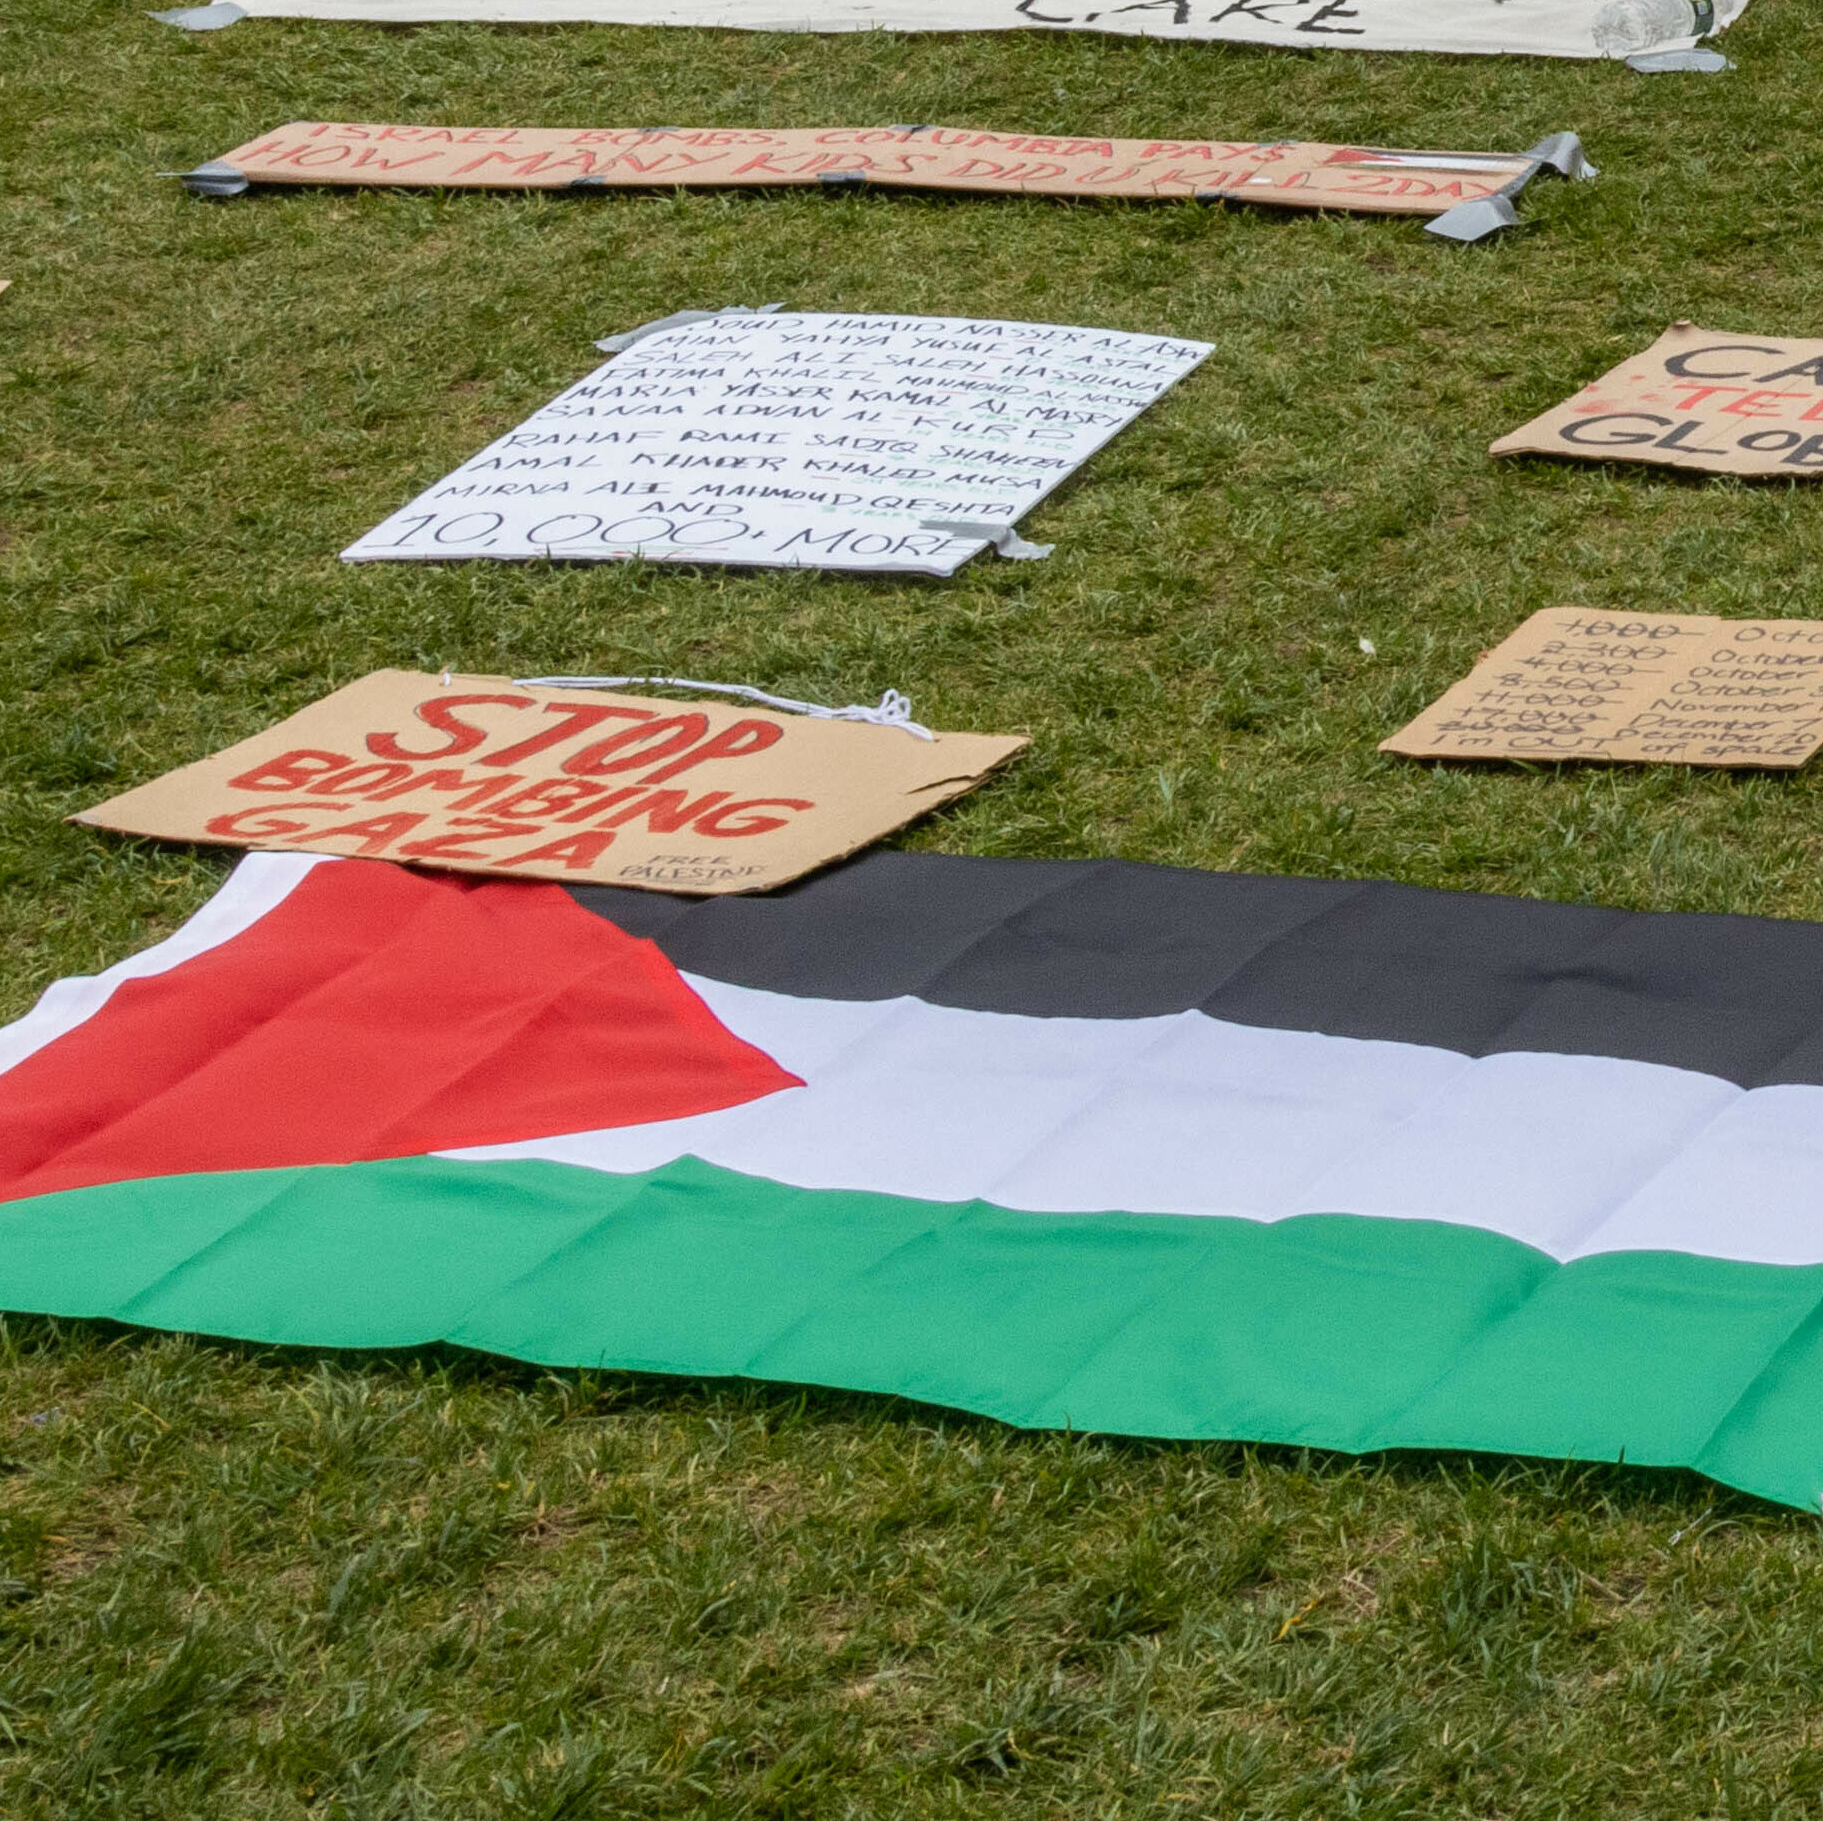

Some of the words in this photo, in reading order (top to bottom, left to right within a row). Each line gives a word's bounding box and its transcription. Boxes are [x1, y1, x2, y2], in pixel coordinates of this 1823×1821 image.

[310, 122, 524, 147] ISRAEL
[813, 125, 1115, 160] COLUMBIA
[1140, 139, 1304, 164] PAYS
[236, 140, 448, 172] HOW
[450, 149, 733, 176] MANY
[729, 151, 937, 177] KIDS
[948, 155, 1069, 185] DID
[1074, 158, 1147, 186] U
[1157, 164, 1321, 192] KILL
[1341, 171, 1509, 202] 2DAY
[651, 333, 752, 347] MIAN
[779, 332, 892, 347] YAHYA
[911, 335, 1010, 356] YUSUF
[824, 318, 947, 334] HAMID
[955, 322, 1087, 345] NASSER
[599, 366, 727, 382] FATIMA
[742, 366, 884, 383] KHALIL
[895, 373, 1030, 396] MAHMOUD
[621, 350, 754, 366] SALEH
[774, 350, 868, 364] ALI
[871, 352, 988, 374] SALEH
[999, 363, 1164, 393] HASSOUNA
[565, 385, 699, 402] MARIA
[720, 382, 835, 401] YASSER
[847, 388, 952, 408] KAMAL
[540, 404, 686, 421] SANAA
[703, 403, 834, 419] ADWAN
[501, 429, 668, 449] RAHAF
[678, 428, 791, 445] RAMI
[804, 433, 920, 455] SADIQ
[937, 444, 1076, 471] SHAHEEN
[467, 454, 606, 473] AMAL
[629, 452, 789, 473] KHADER
[802, 458, 936, 481] KHALED
[943, 472, 1043, 491] MUSA
[433, 480, 570, 500] MIRNA
[689, 483, 862, 507] MAHMOUD
[869, 493, 1017, 517] QESHTA
[637, 500, 746, 517] AND
[773, 526, 986, 557] MORE
[1688, 665, 1821, 682] October
[1669, 680, 1806, 698] October
[1649, 697, 1814, 714] November
[1628, 713, 1784, 732] December
[1790, 717, 1823, 732] 7
[365, 692, 786, 786] STOP
[1613, 728, 1776, 746] December
[1773, 732, 1818, 746] 20
[1640, 741, 1689, 757] of
[1702, 743, 1808, 757] space
[226, 748, 817, 839] BOMBING
[204, 800, 617, 870] GAZA
[647, 854, 734, 866] FREE
